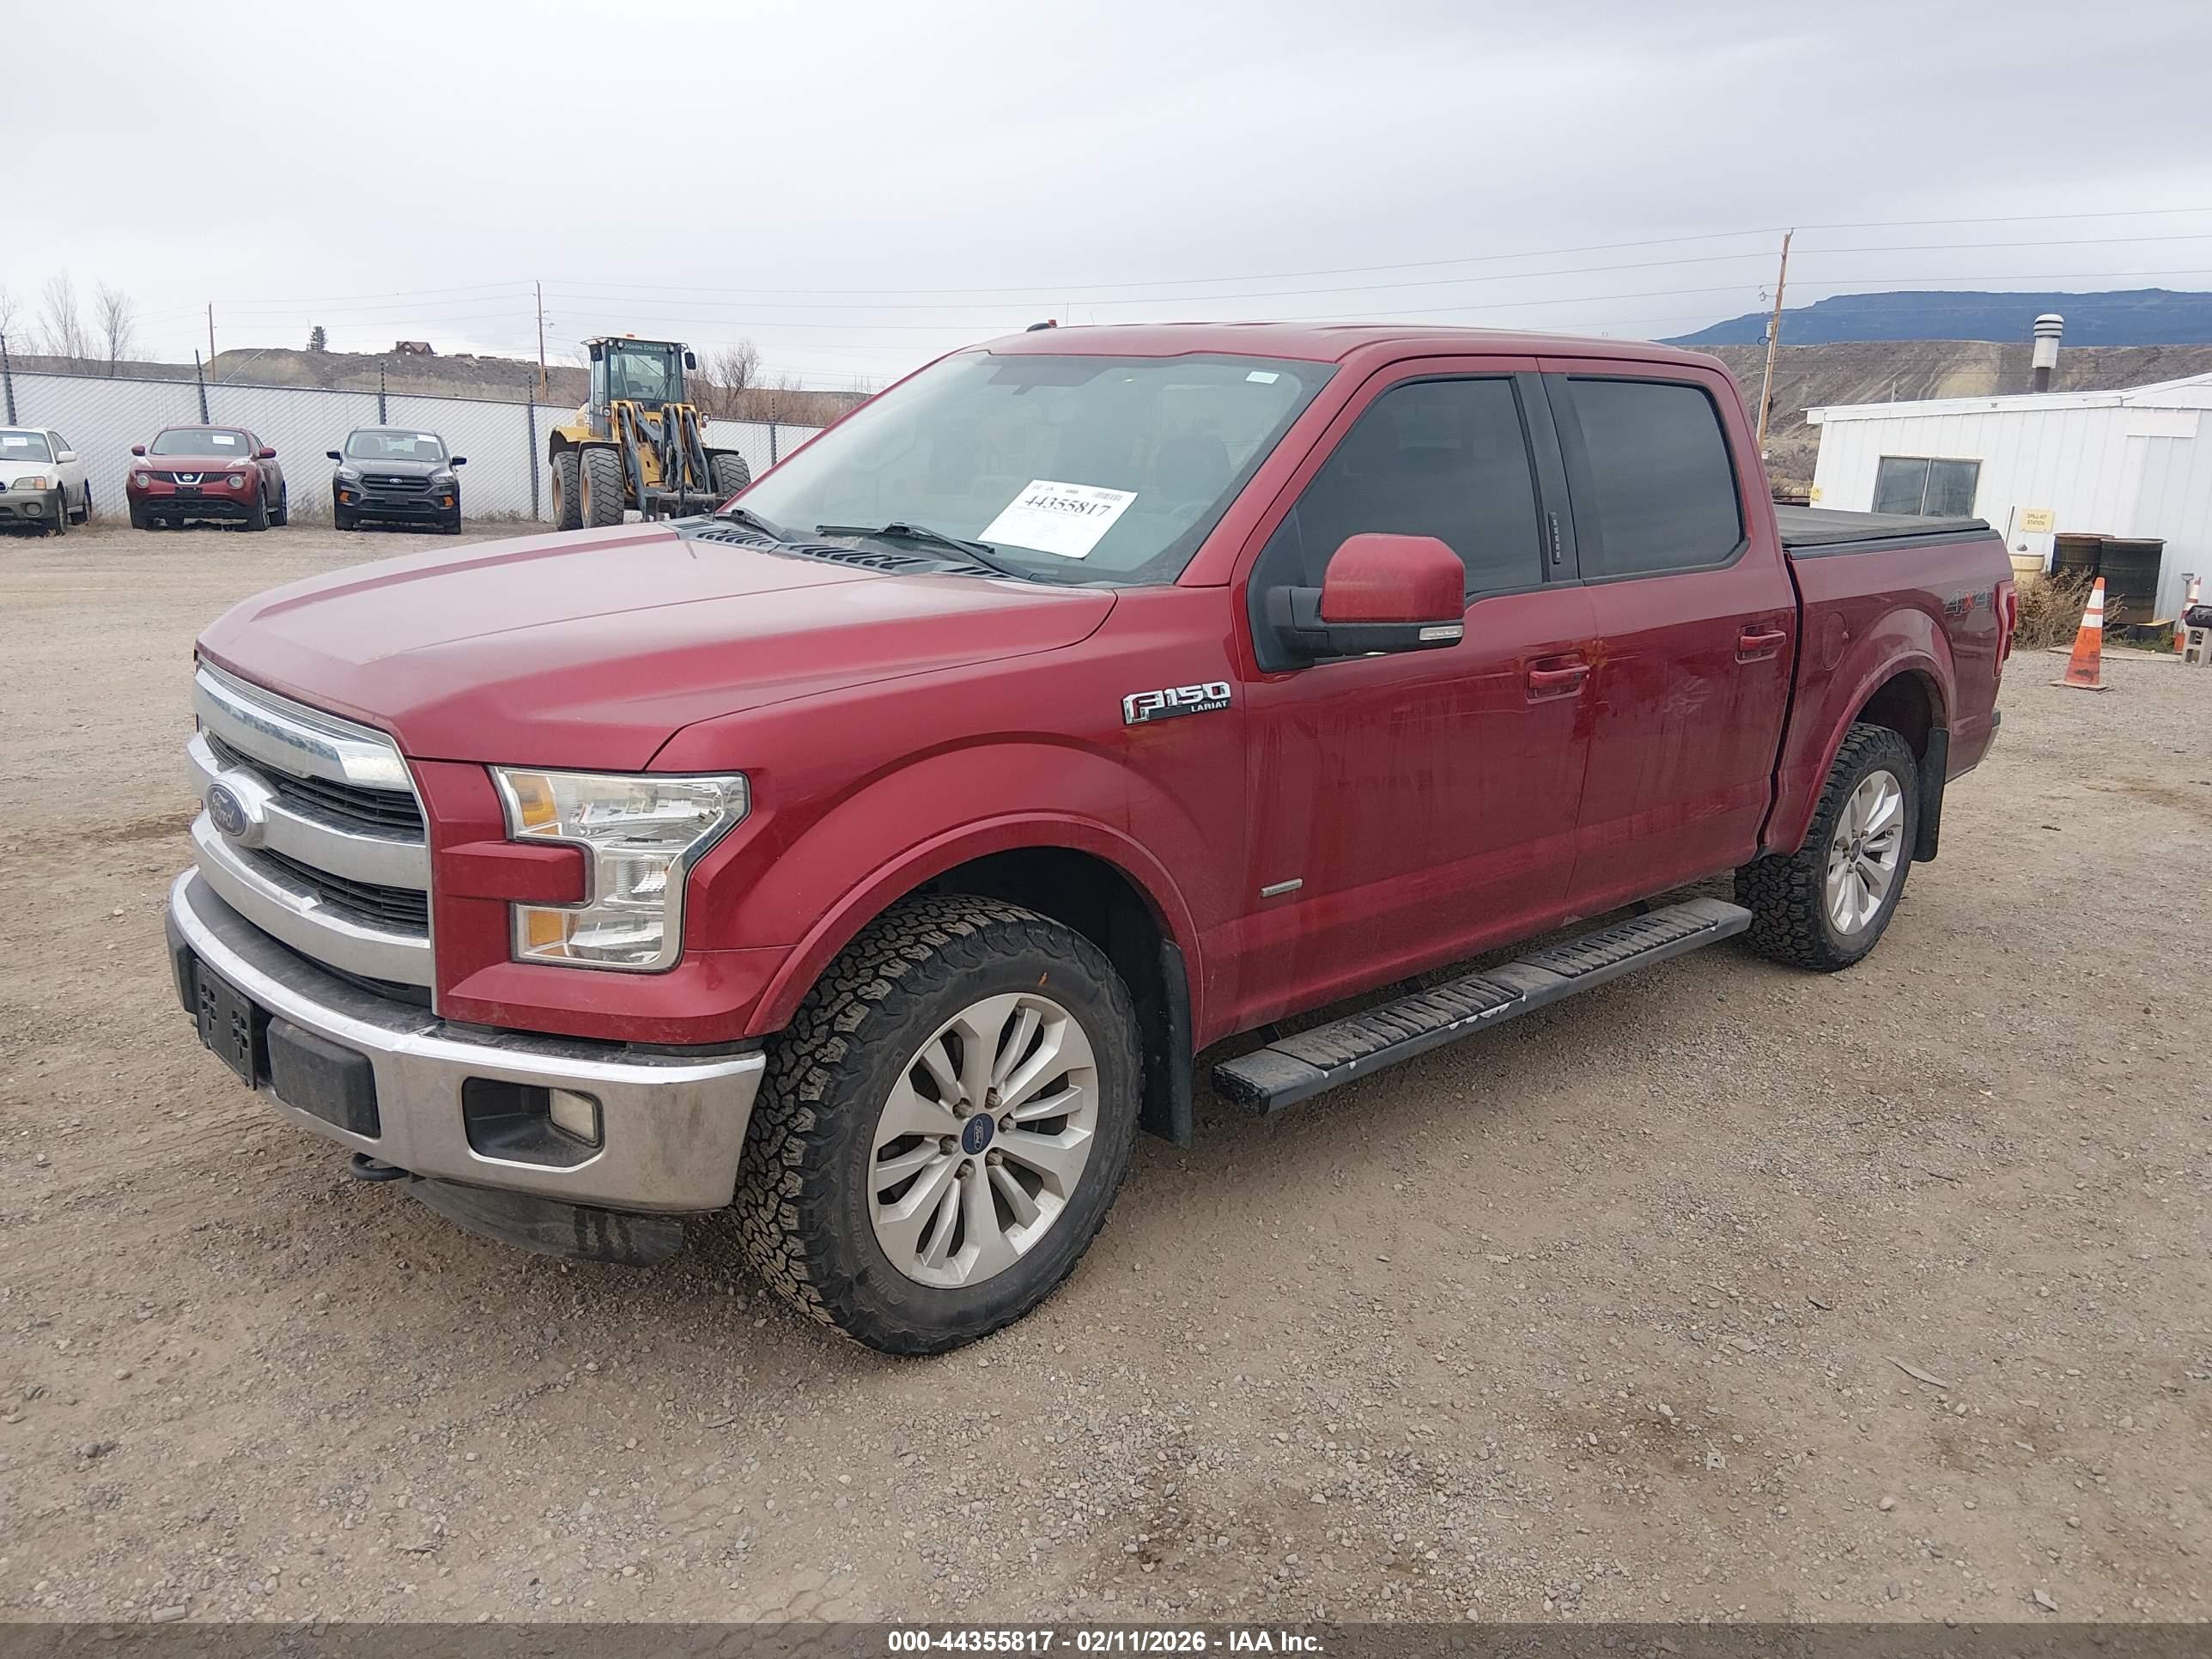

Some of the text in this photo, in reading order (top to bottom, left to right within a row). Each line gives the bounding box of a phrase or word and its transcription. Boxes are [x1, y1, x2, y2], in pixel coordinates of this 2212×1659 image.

[1025, 495, 1112, 517] 44355817
[1191, 700, 1228, 713] LARIAT
[211, 792, 234, 828] Ford
